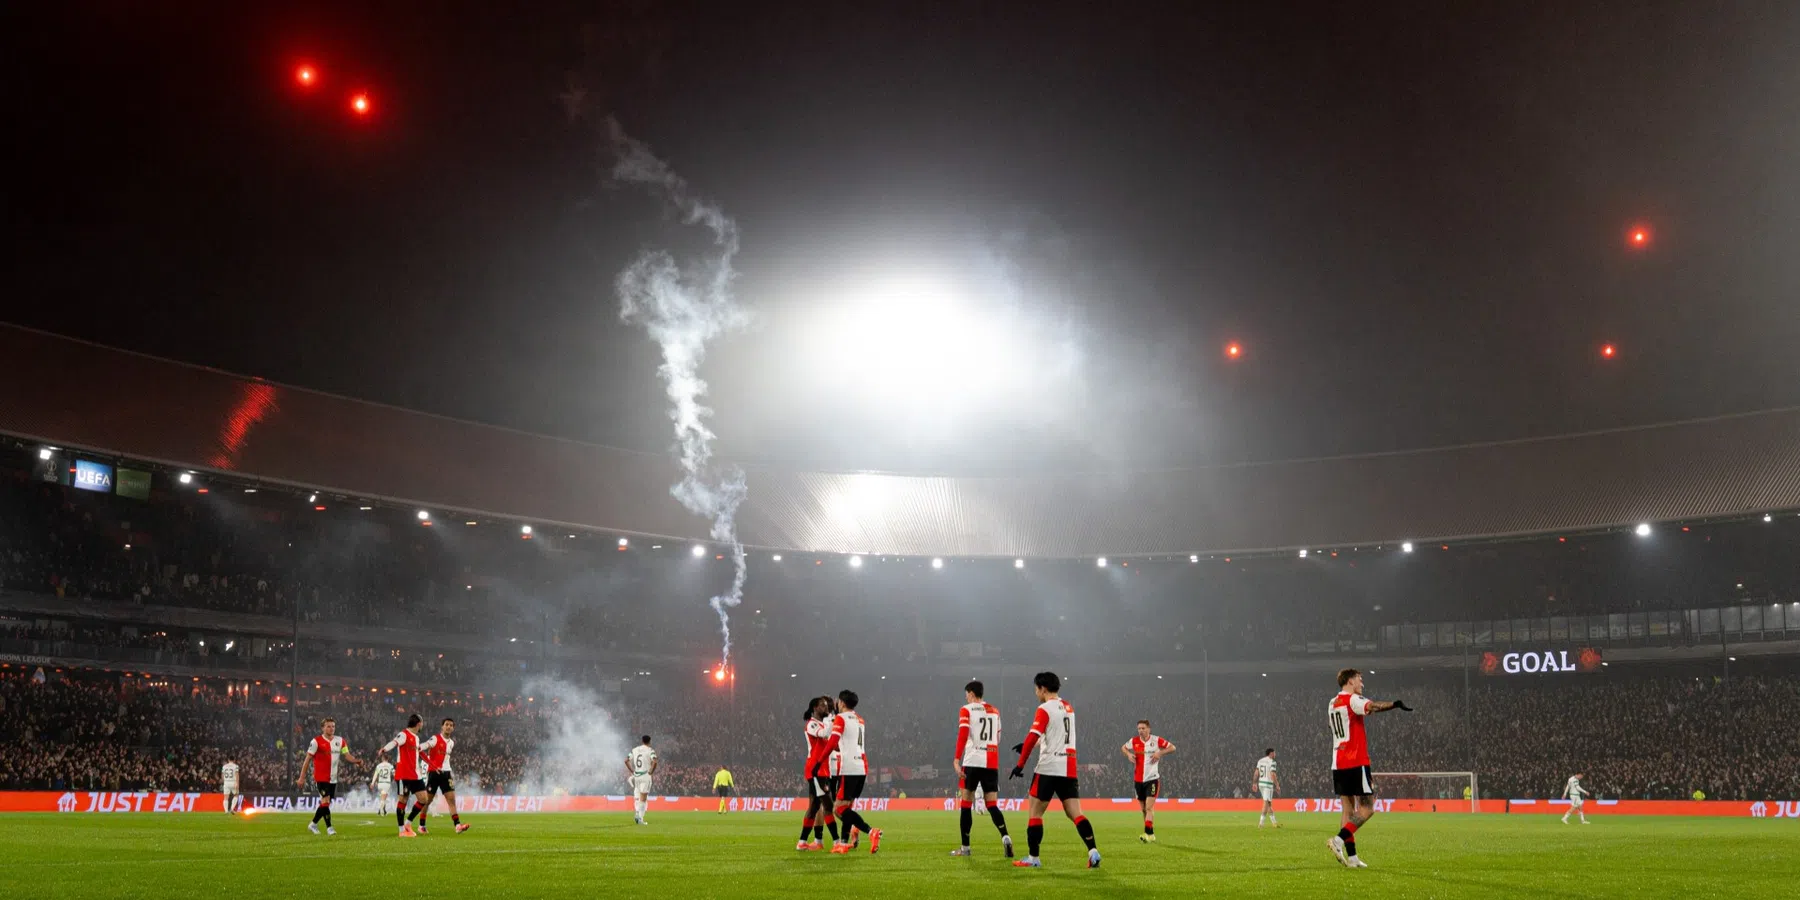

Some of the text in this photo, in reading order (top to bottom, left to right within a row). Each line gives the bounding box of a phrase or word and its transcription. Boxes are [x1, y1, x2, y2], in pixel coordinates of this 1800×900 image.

[77, 468, 111, 486] UEFA
[1502, 651, 1576, 674] GOAL
[979, 717, 993, 741] 21
[1063, 716, 1071, 745] 9
[636, 754, 643, 768] 6
[85, 792, 201, 812] JUST EAT
[253, 796, 291, 810] UEFA
[472, 795, 546, 812] JUST EAT
[742, 797, 795, 811] JUST EAT
[870, 797, 889, 811] EAT
[996, 798, 1024, 811] EAT
[1313, 798, 1396, 812] JUS AT
